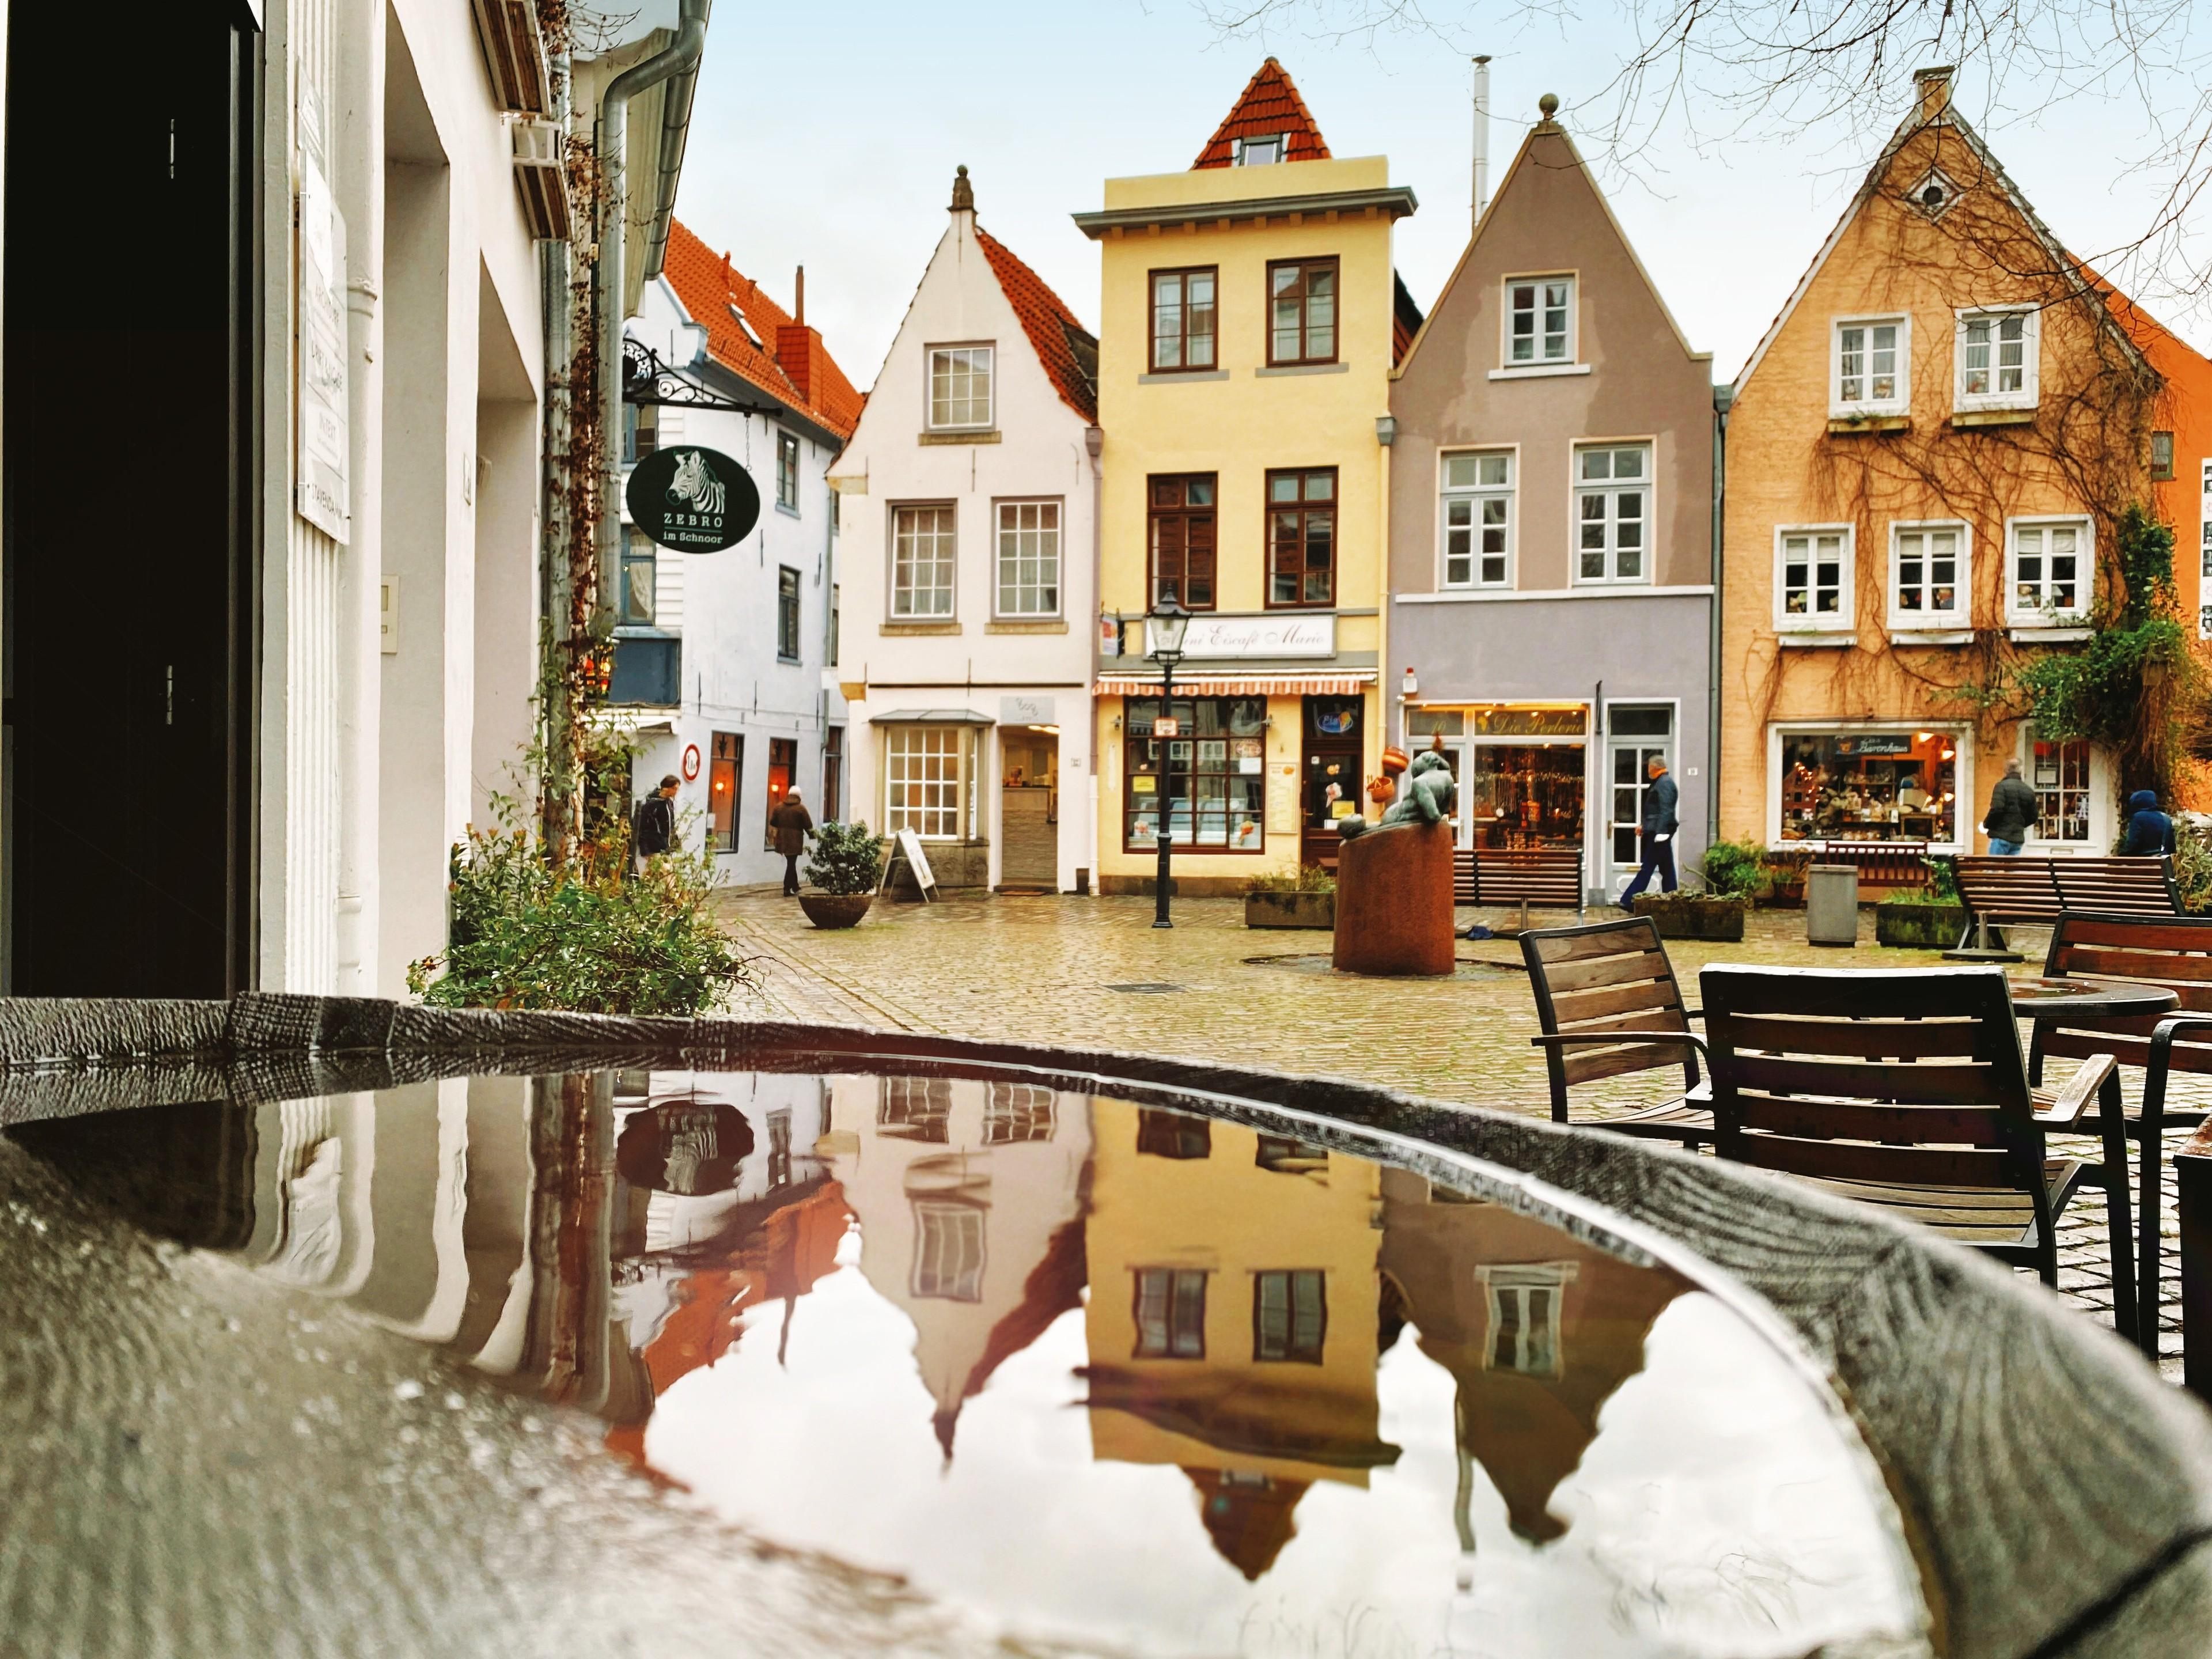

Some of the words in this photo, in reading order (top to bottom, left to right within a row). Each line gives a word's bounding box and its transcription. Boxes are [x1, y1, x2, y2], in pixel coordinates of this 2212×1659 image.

[664, 513, 722, 528] ZEBRO
[663, 531, 676, 540] im
[680, 532, 723, 544] Schnoor
[1265, 624, 1325, 646] Mario
[1493, 714, 1522, 734] Die
[1525, 714, 1585, 734] Perlerie
